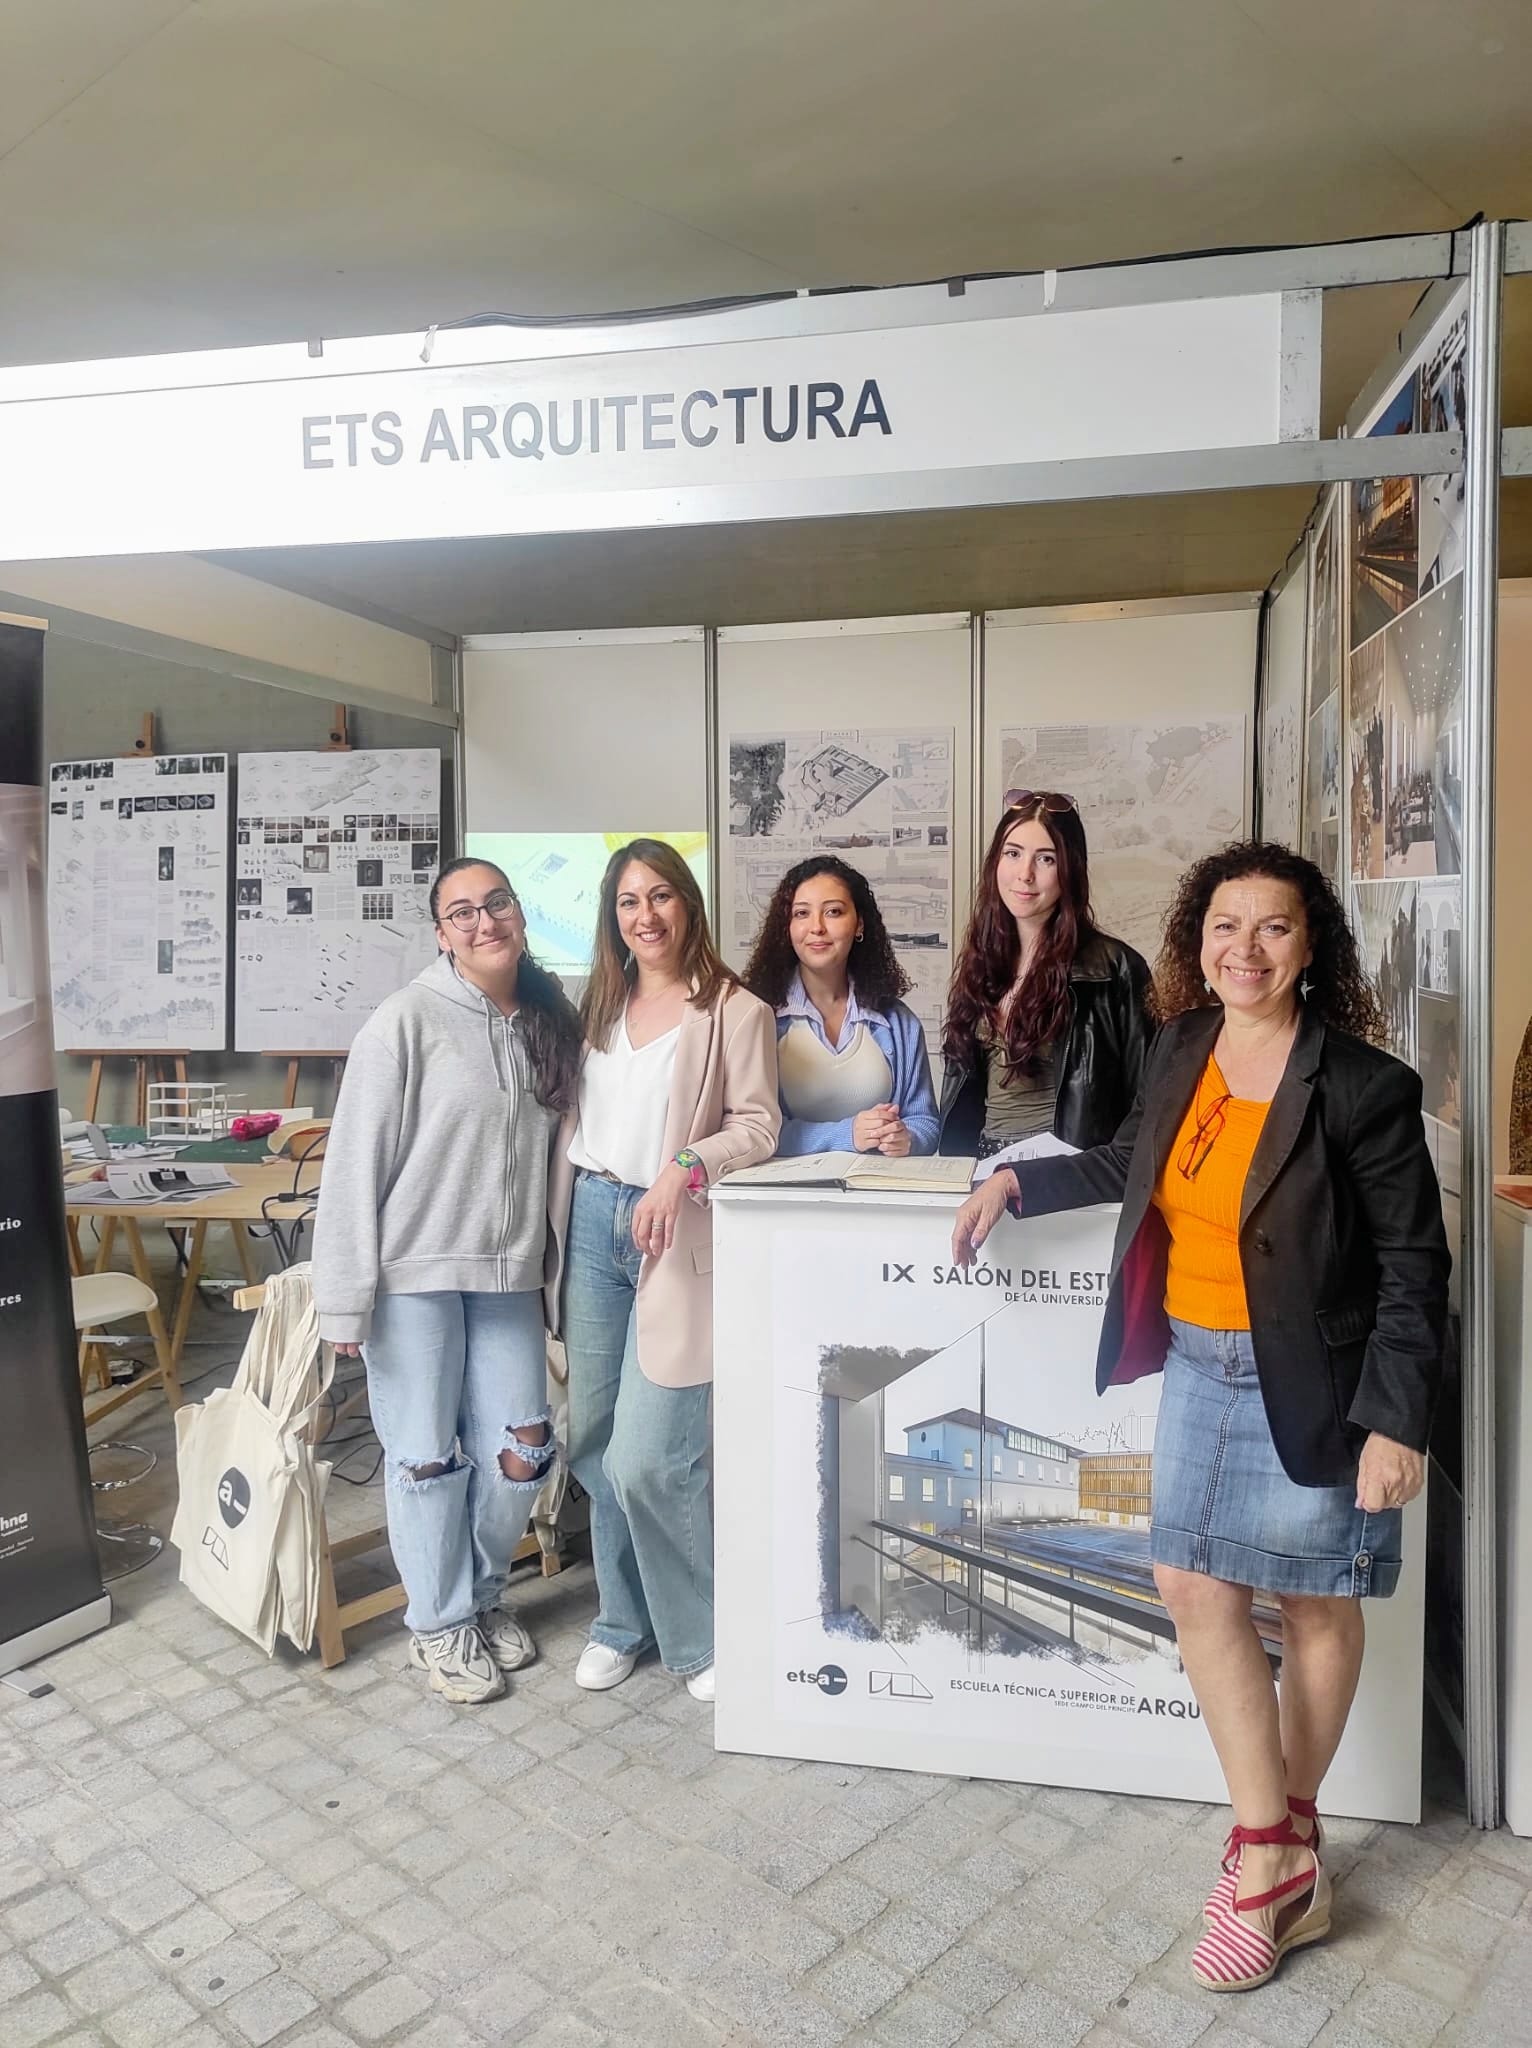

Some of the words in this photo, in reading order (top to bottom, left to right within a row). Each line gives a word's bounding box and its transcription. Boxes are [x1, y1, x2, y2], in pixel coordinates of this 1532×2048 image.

[302, 411, 404, 468] ETS
[420, 378, 893, 462] ARQUITECTURA
[881, 1263, 916, 1283] IX
[932, 1261, 1012, 1288] SALÓN
[1021, 1269, 1062, 1290] DEL
[1070, 1271, 1110, 1292] EST
[1004, 1292, 1020, 1303] DE
[1023, 1293, 1038, 1304] LA
[1041, 1294, 1106, 1307] UNIVERSID
[950, 1679, 1001, 1694] ESCUELA
[1003, 1682, 1056, 1699] TÉCNICA
[1060, 1689, 1117, 1705] SUPERIOR
[1121, 1695, 1136, 1706] DE
